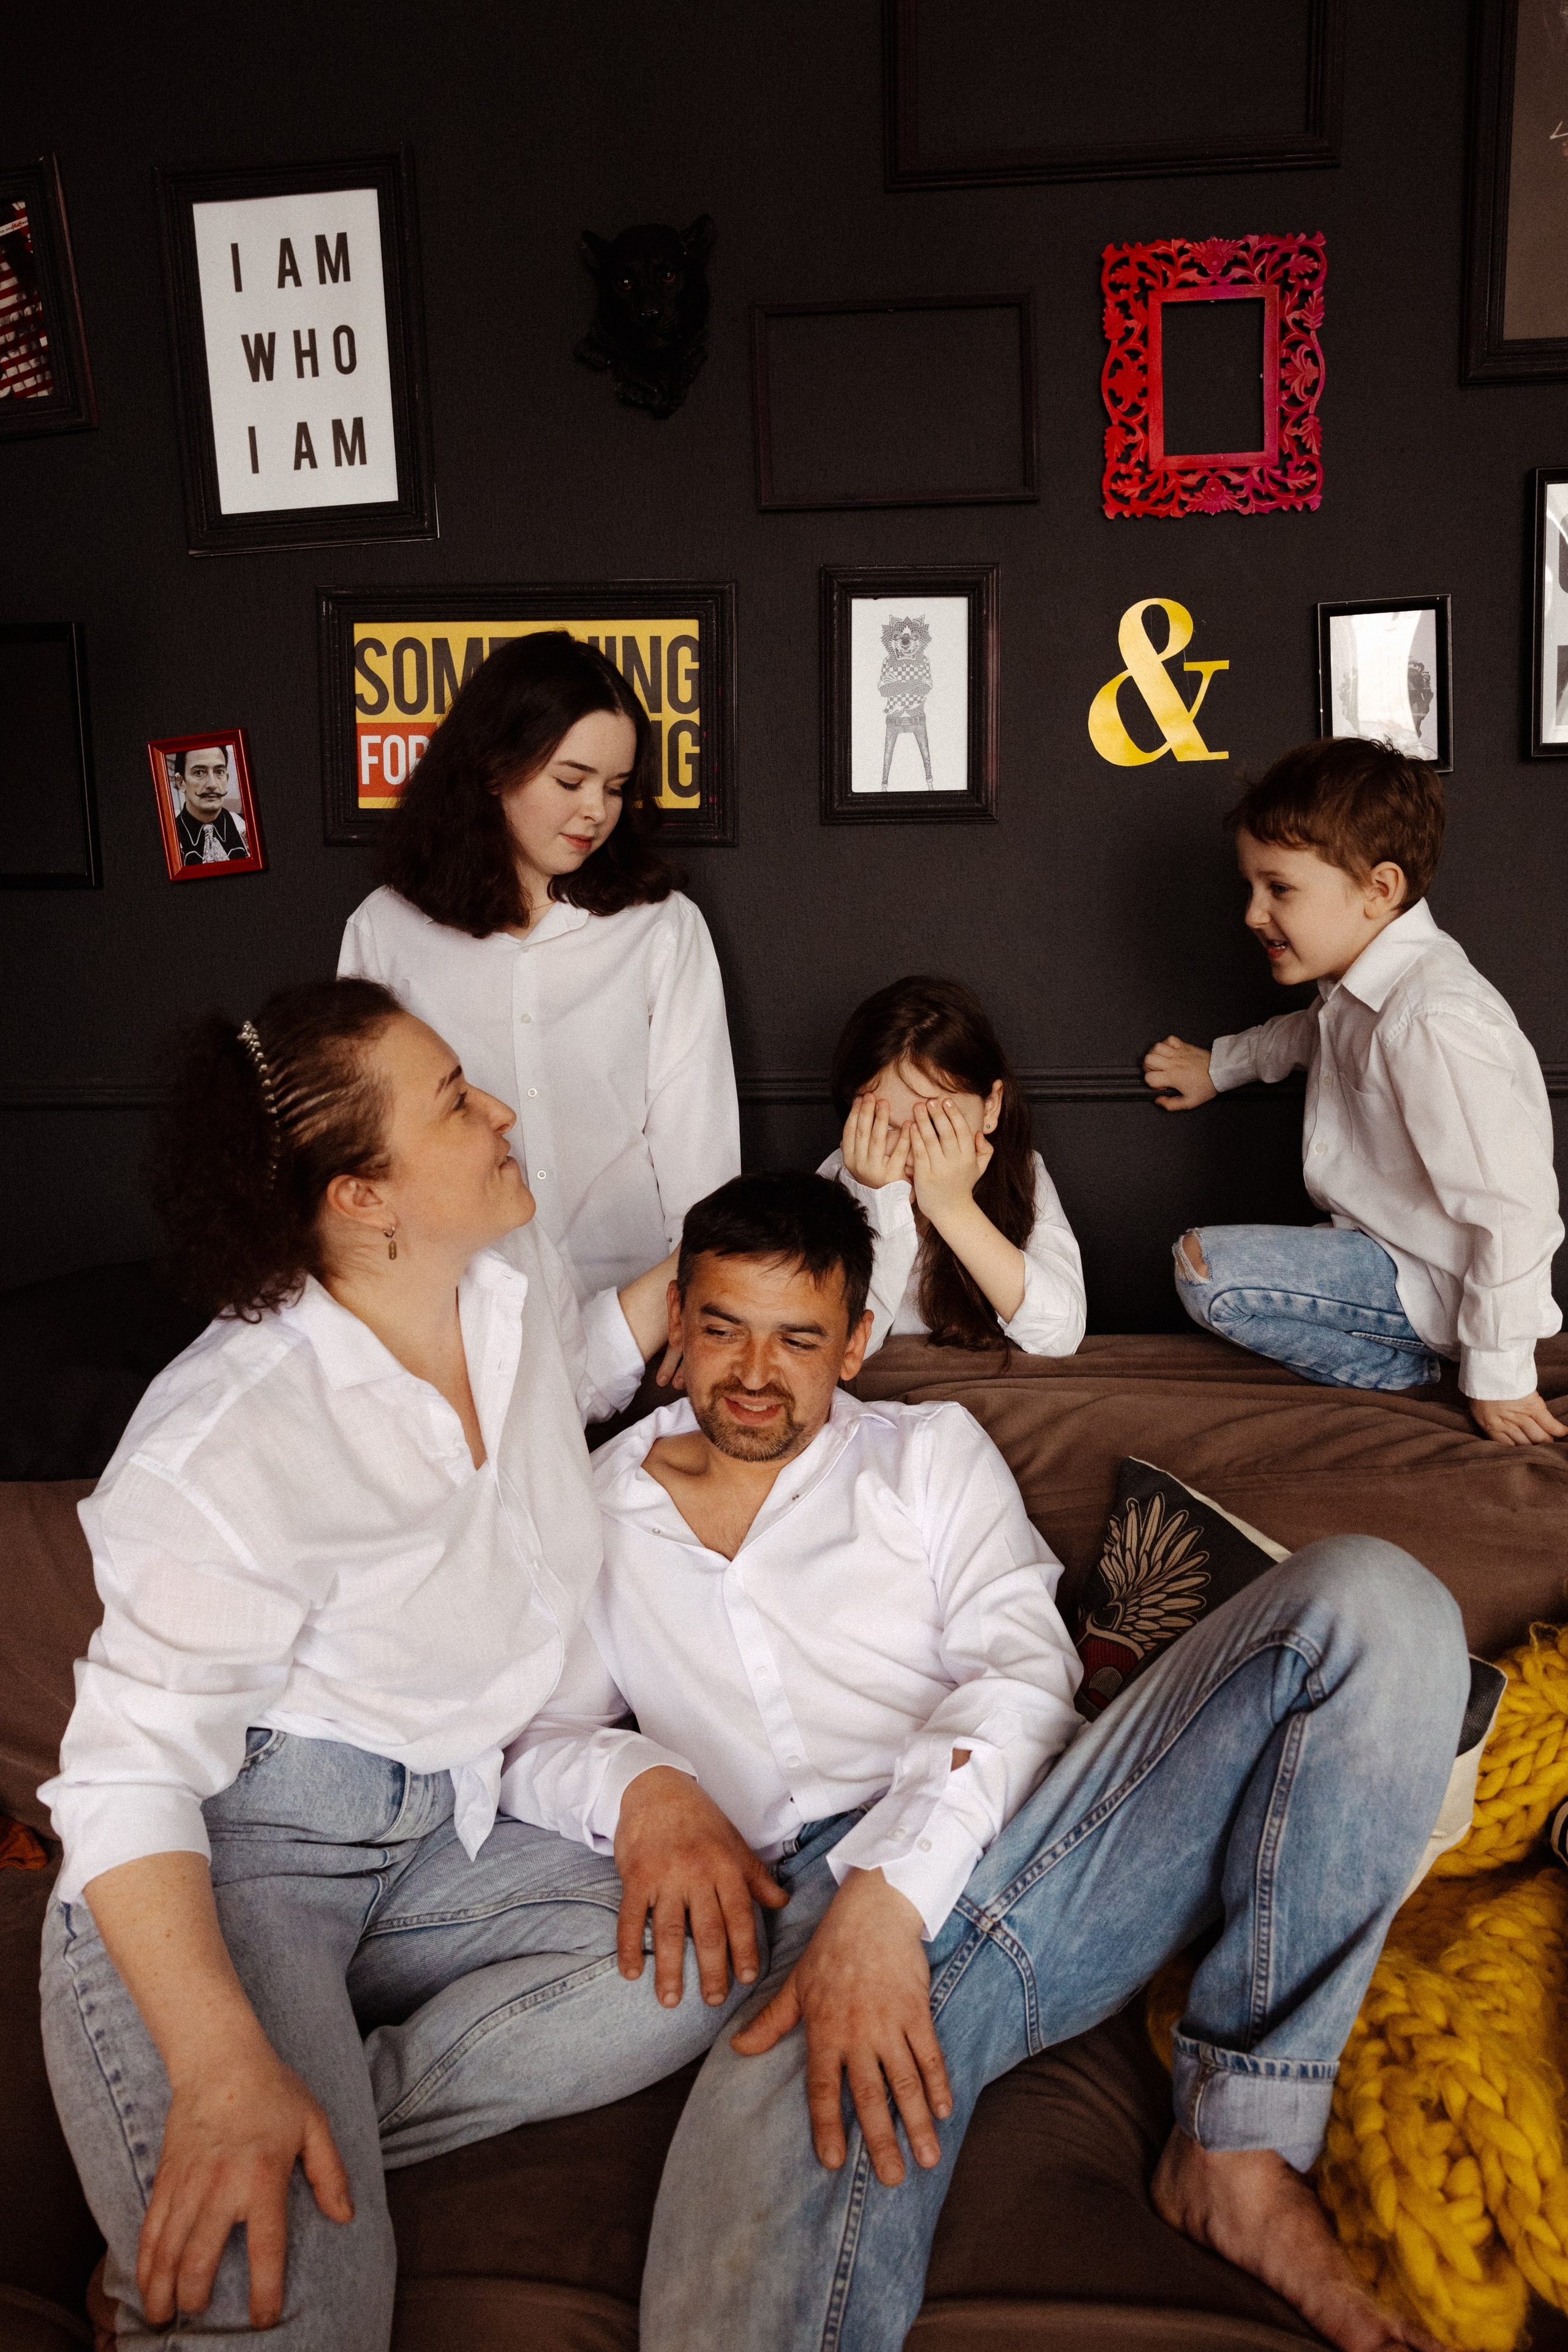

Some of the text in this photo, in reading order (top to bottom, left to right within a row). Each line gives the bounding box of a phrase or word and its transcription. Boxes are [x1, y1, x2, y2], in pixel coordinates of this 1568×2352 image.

[230, 232, 351, 292] I AM
[241, 325, 357, 382] WHO
[248, 417, 367, 473] I AM
[355, 635, 699, 715] SOMNG
[1088, 598, 1229, 766] &
